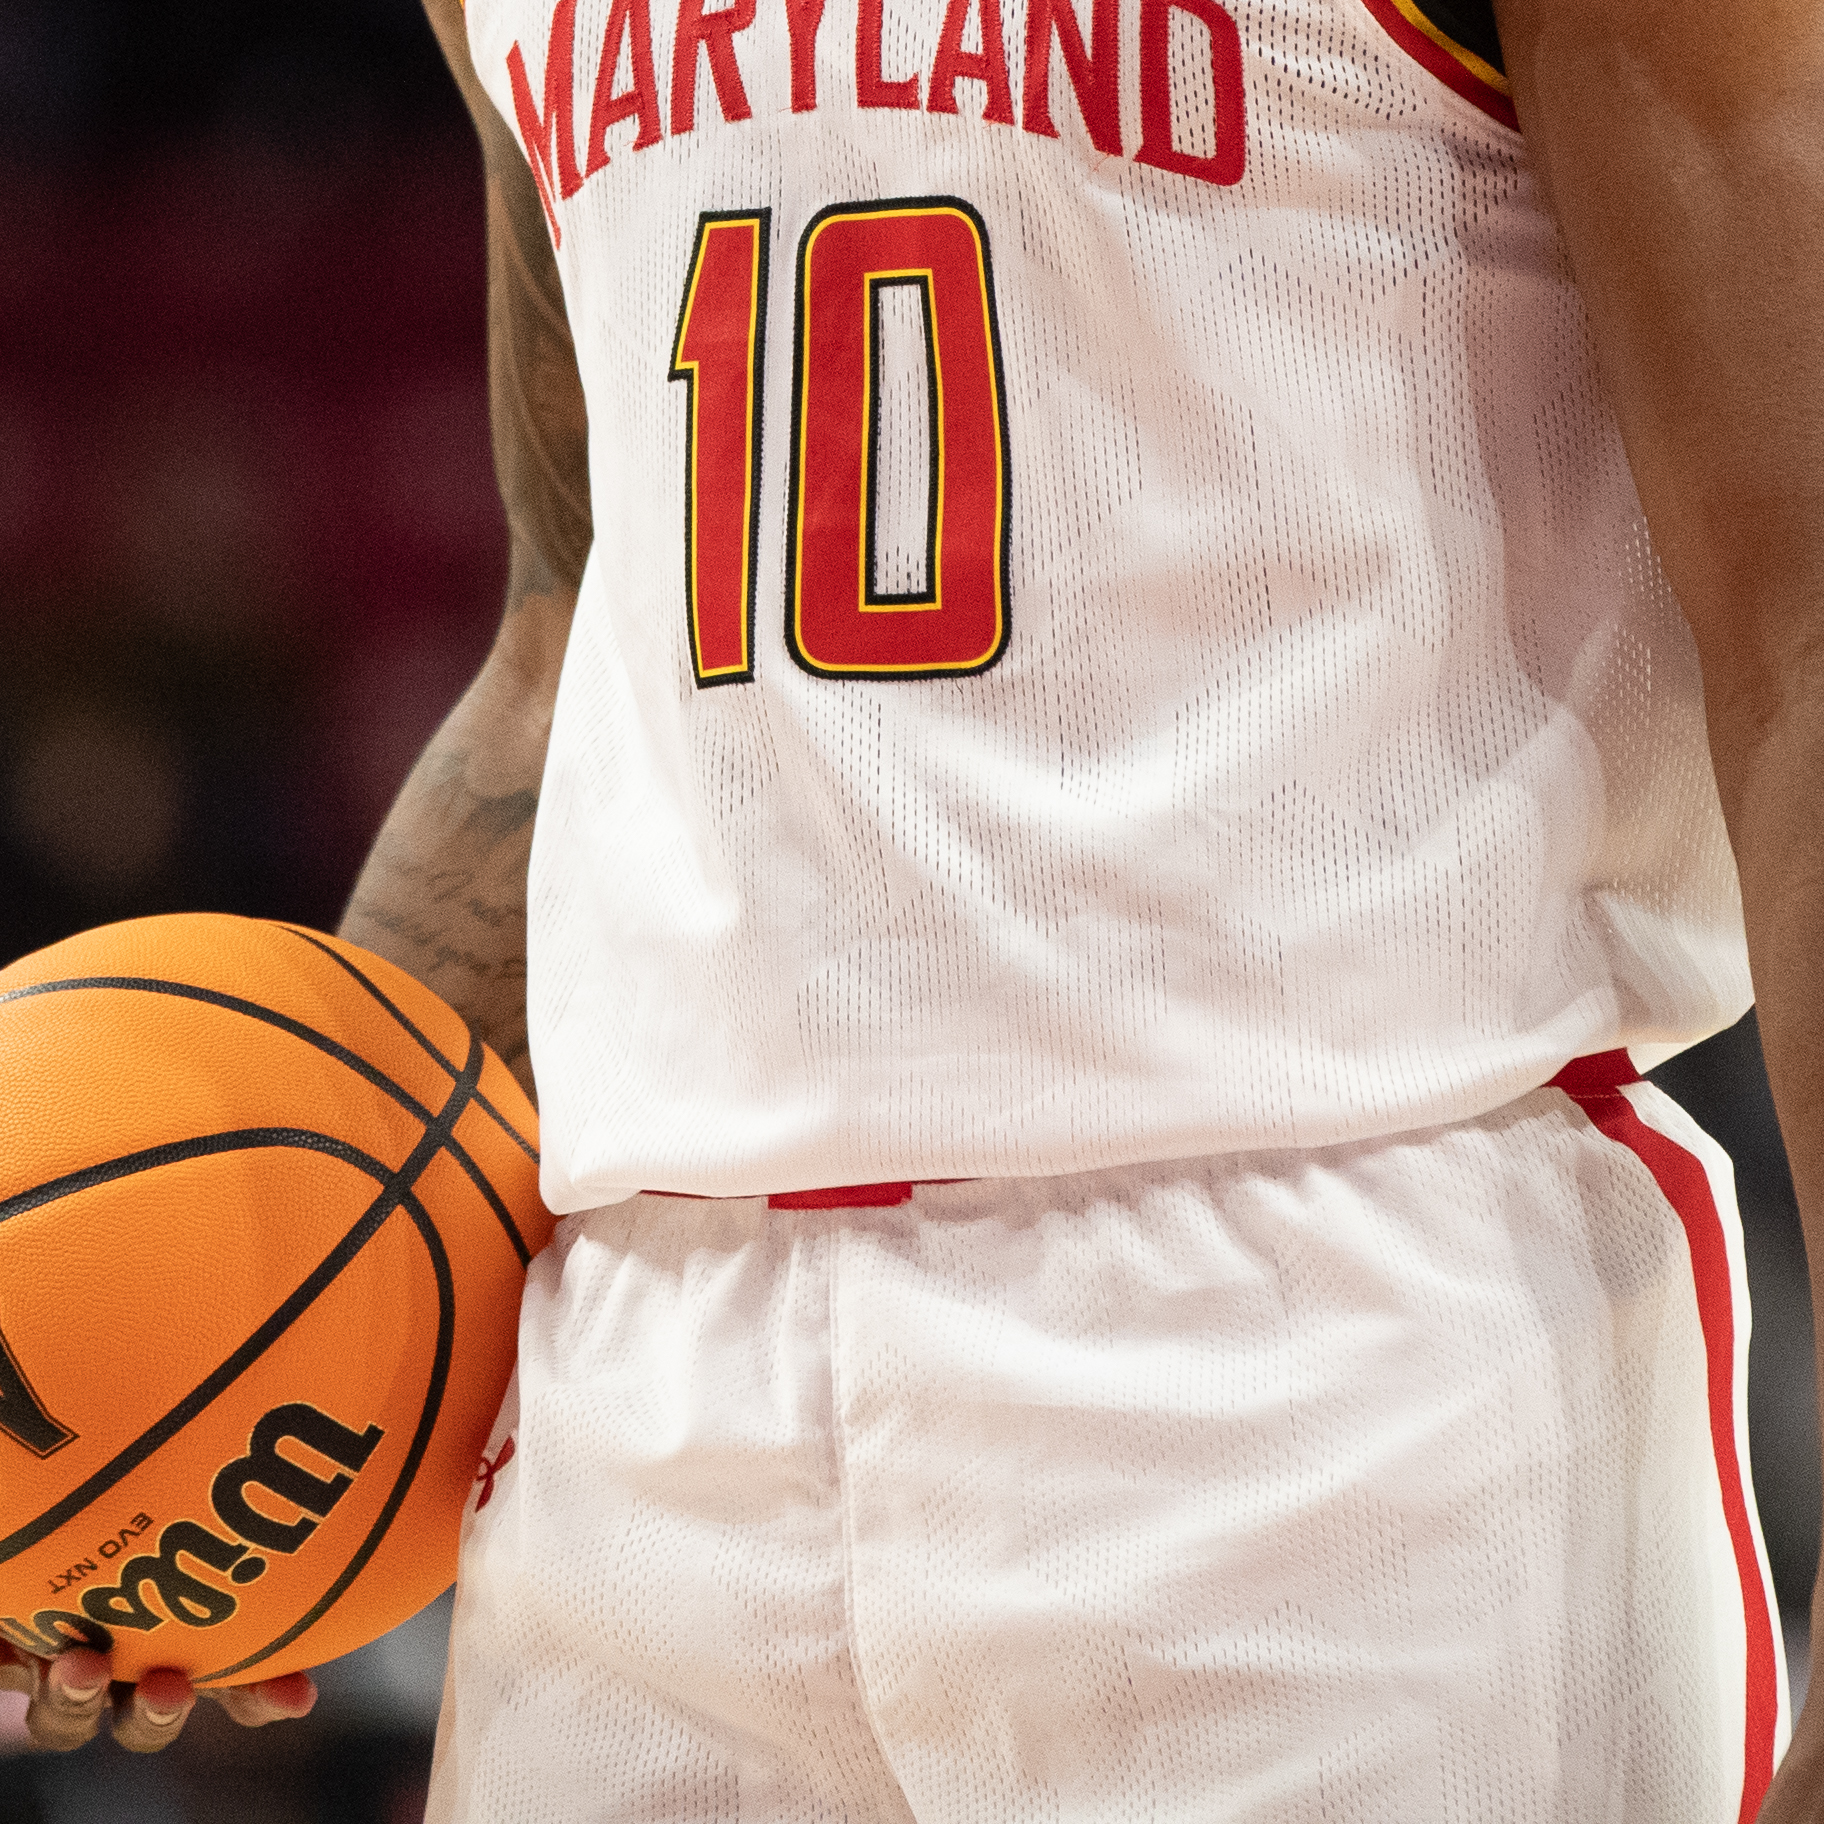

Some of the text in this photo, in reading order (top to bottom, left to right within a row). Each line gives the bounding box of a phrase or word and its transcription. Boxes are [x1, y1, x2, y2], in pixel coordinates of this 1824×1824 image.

[667, 195, 1012, 690] 10
[47, 1512, 155, 1594] EVO NXT
